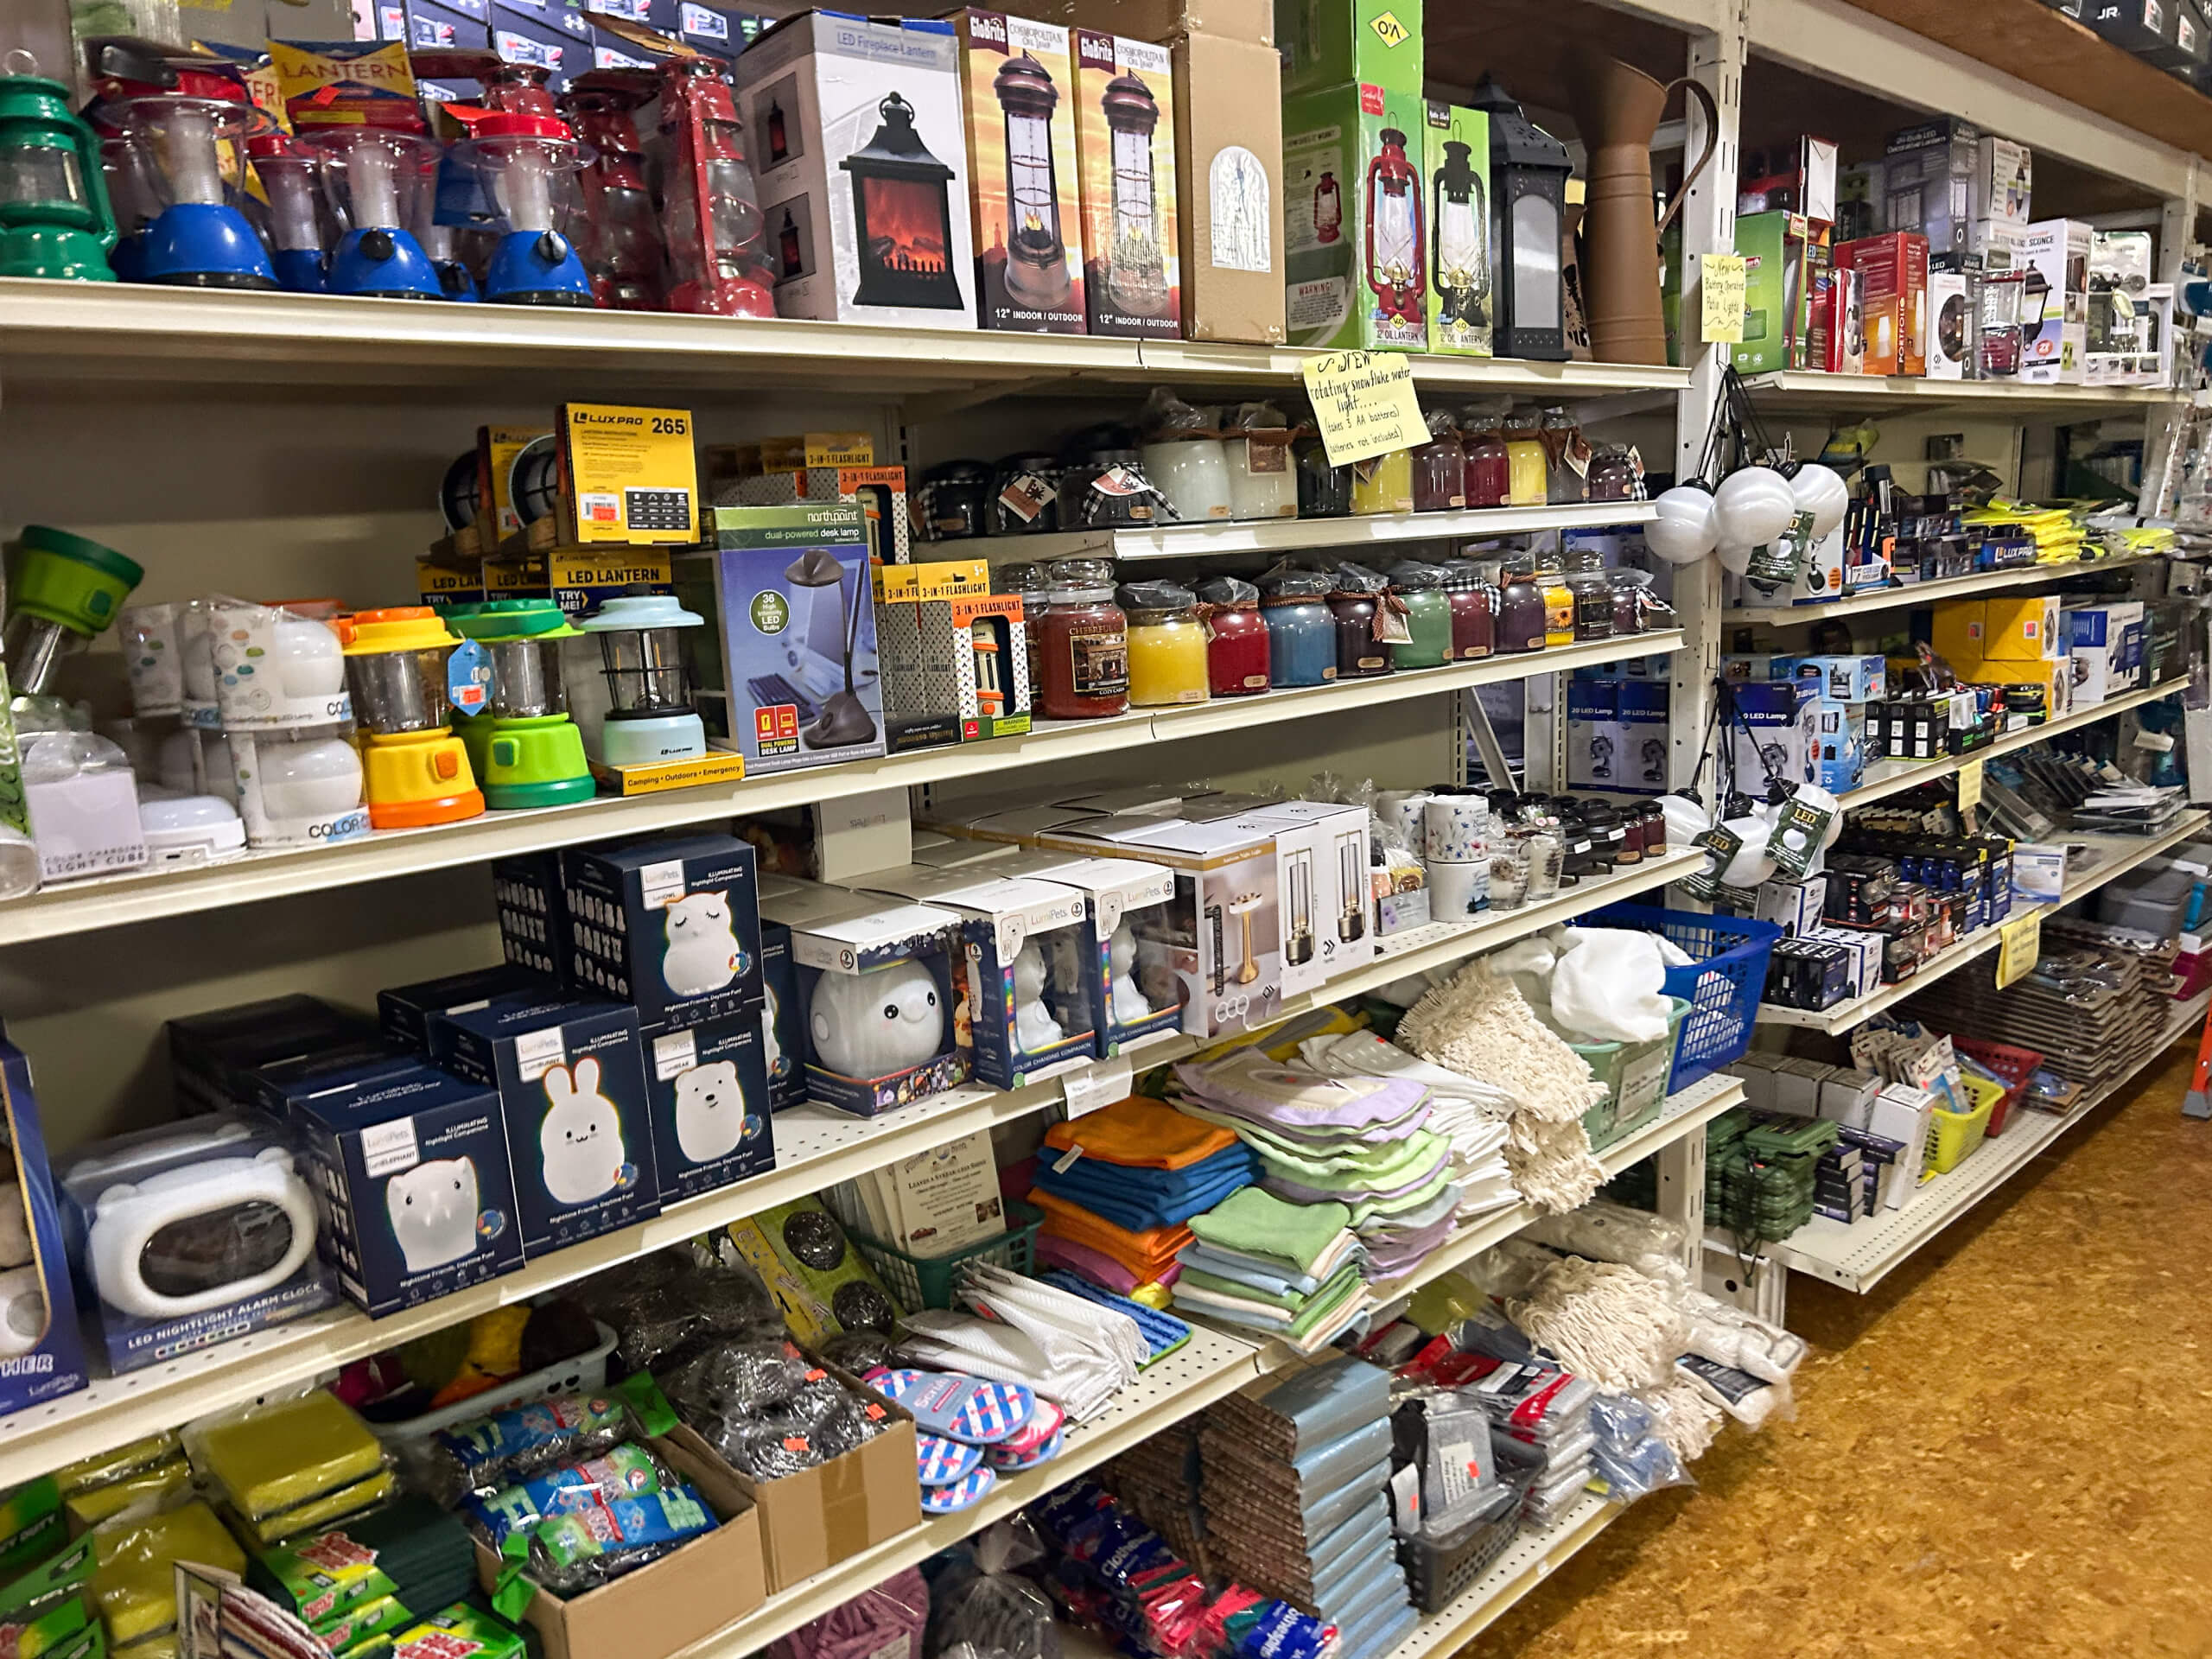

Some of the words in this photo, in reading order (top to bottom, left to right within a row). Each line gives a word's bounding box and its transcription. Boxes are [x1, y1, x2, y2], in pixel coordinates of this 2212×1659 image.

[969, 16, 1006, 42] GloBrite
[837, 31, 855, 46] LED
[857, 35, 899, 53] Fireplace
[900, 41, 936, 58] Lantern
[1081, 37, 1113, 62] GloBrite
[280, 61, 408, 79] LANTERN
[1299, 281, 1333, 295] WARNING!
[1013, 311, 1042, 321] INDOOR
[1048, 312, 1084, 322] OUTDOOR
[1115, 316, 1141, 327] INDOOR
[1146, 318, 1179, 328] OUTDOOR
[1311, 380, 1350, 401] rotating
[1391, 366, 1411, 382] water
[589, 415, 643, 425] LUXPRO
[652, 416, 686, 435] 265
[1357, 415, 1366, 426] AA
[831, 453, 870, 464] FLASHLIGHT
[808, 510, 858, 525] northpoint
[765, 529, 819, 540] dual-powered
[820, 528, 838, 538] desk
[840, 527, 860, 539] lamp
[567, 569, 594, 584] LED
[597, 569, 659, 583] LANTERN
[559, 590, 582, 601] TRY
[922, 587, 944, 598] 3-IN-1
[946, 582, 987, 595] FLASHLIGHT
[560, 601, 581, 611] ME!
[762, 594, 774, 603] 36
[956, 605, 979, 616] 3-IN-1
[981, 601, 1020, 613] FLASHLIGHT
[761, 615, 779, 624] LED
[628, 776, 659, 787] Camping
[665, 772, 697, 781] Outdoors
[702, 765, 741, 776] Emergency
[1793, 808, 1817, 823] LED
[308, 818, 360, 838] COLOR
[1707, 835, 1729, 850] LED
[46, 858, 97, 876] LIGHT
[106, 851, 146, 867] CUBE
[1128, 885, 1160, 902] LumiPets
[1031, 908, 1068, 925] LumiPets
[1013, 1059, 1033, 1072] COLOR
[1033, 1052, 1060, 1065] CHANGING
[1060, 1042, 1091, 1060] COMPANION
[128, 1334, 153, 1350] LED
[156, 1309, 234, 1340] NIGHTLIGHT
[238, 1295, 279, 1315] ALARM
[282, 1281, 321, 1302] CLOCK
